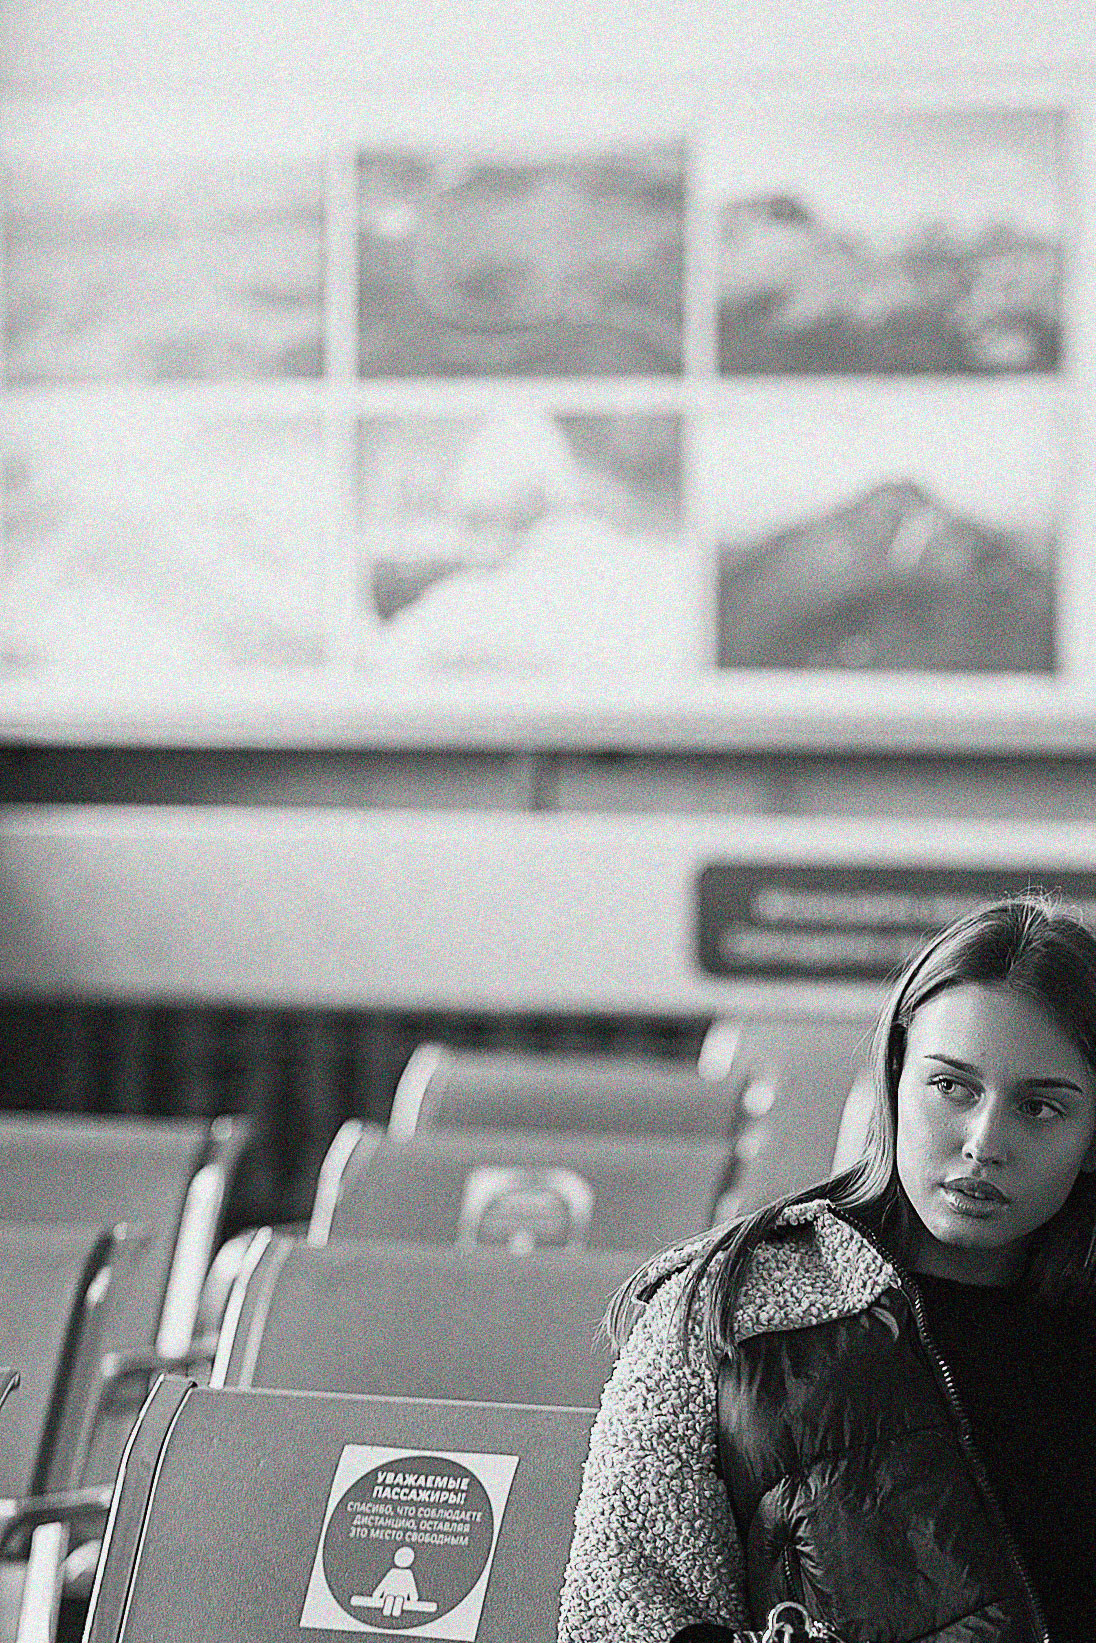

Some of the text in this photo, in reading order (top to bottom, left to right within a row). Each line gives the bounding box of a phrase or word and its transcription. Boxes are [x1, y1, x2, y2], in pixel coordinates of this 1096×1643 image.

[377, 1470, 470, 1490] УВАЖАЕМЫЕ
[372, 1485, 466, 1505] ПАССАЖИРЫ!
[396, 1506, 416, 1517] ЧТО
